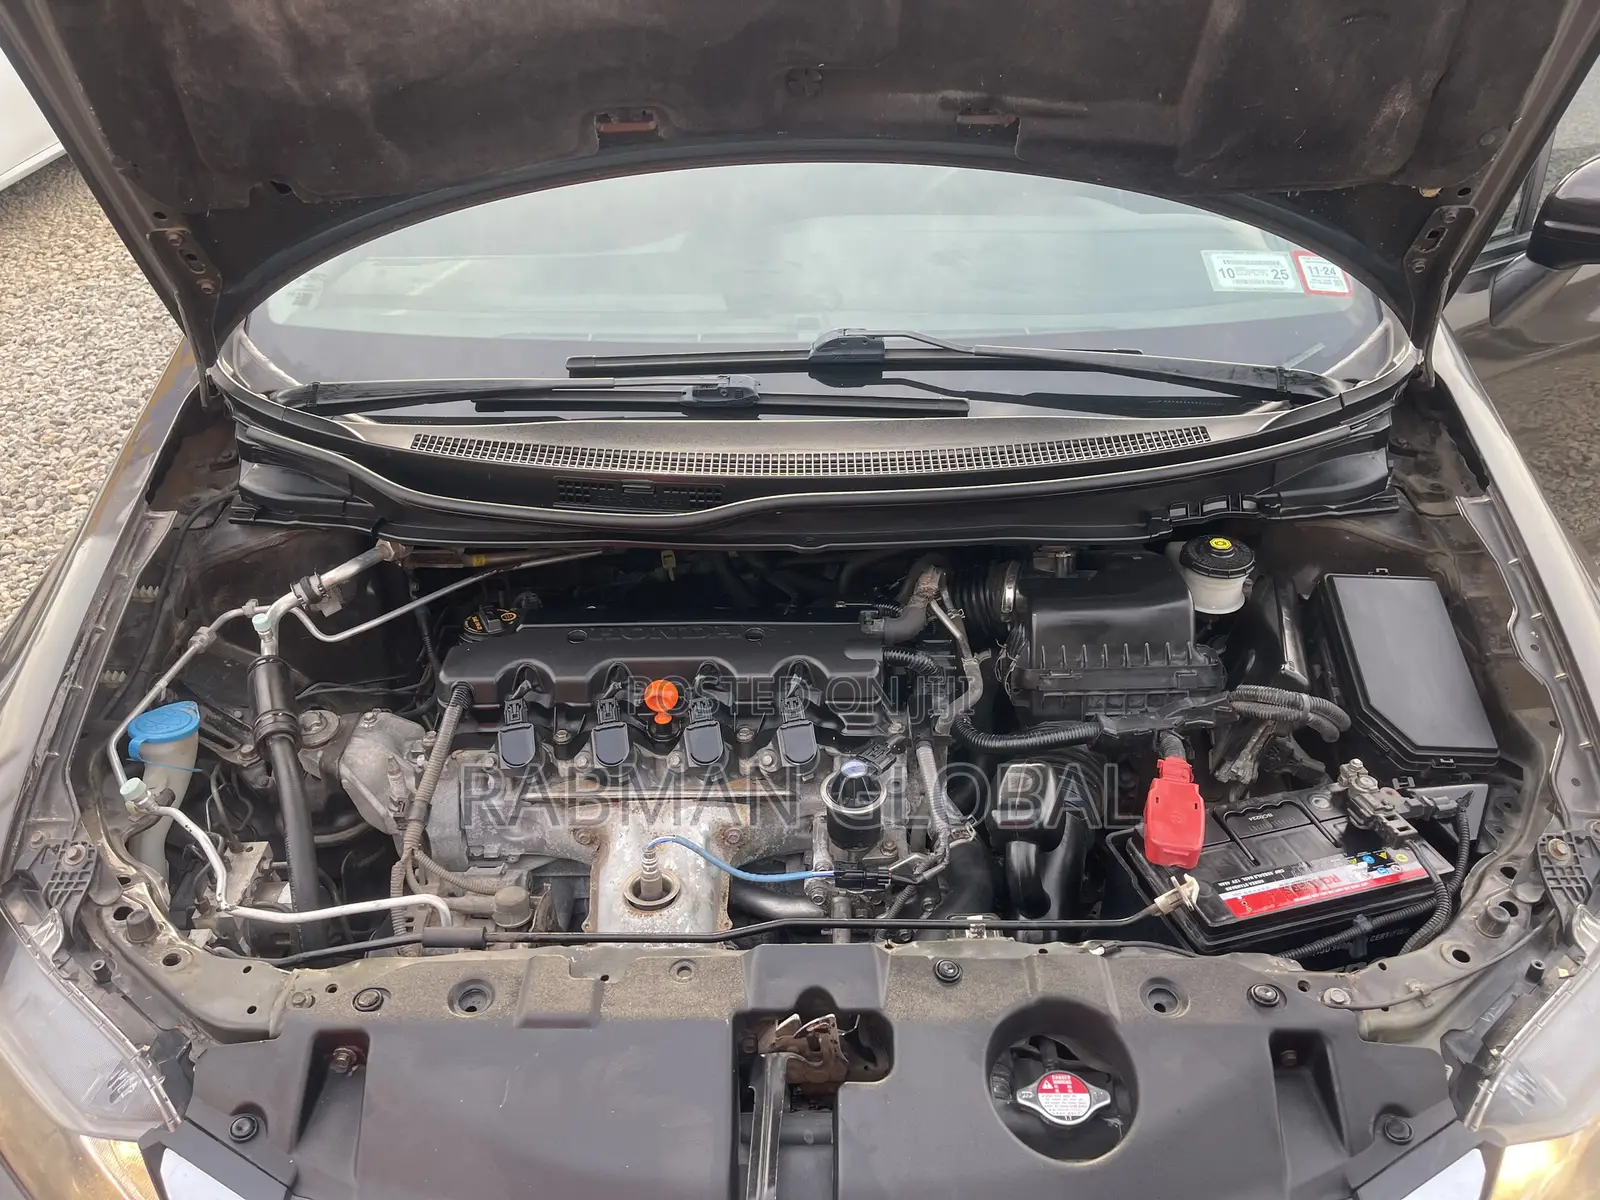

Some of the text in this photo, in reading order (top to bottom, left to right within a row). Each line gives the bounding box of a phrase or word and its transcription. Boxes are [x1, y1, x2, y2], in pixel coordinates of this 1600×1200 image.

[1218, 267, 1236, 279] 10
[1271, 268, 1289, 280] 25
[1307, 265, 1337, 276] 11-24
[588, 626, 742, 640] HONDA
